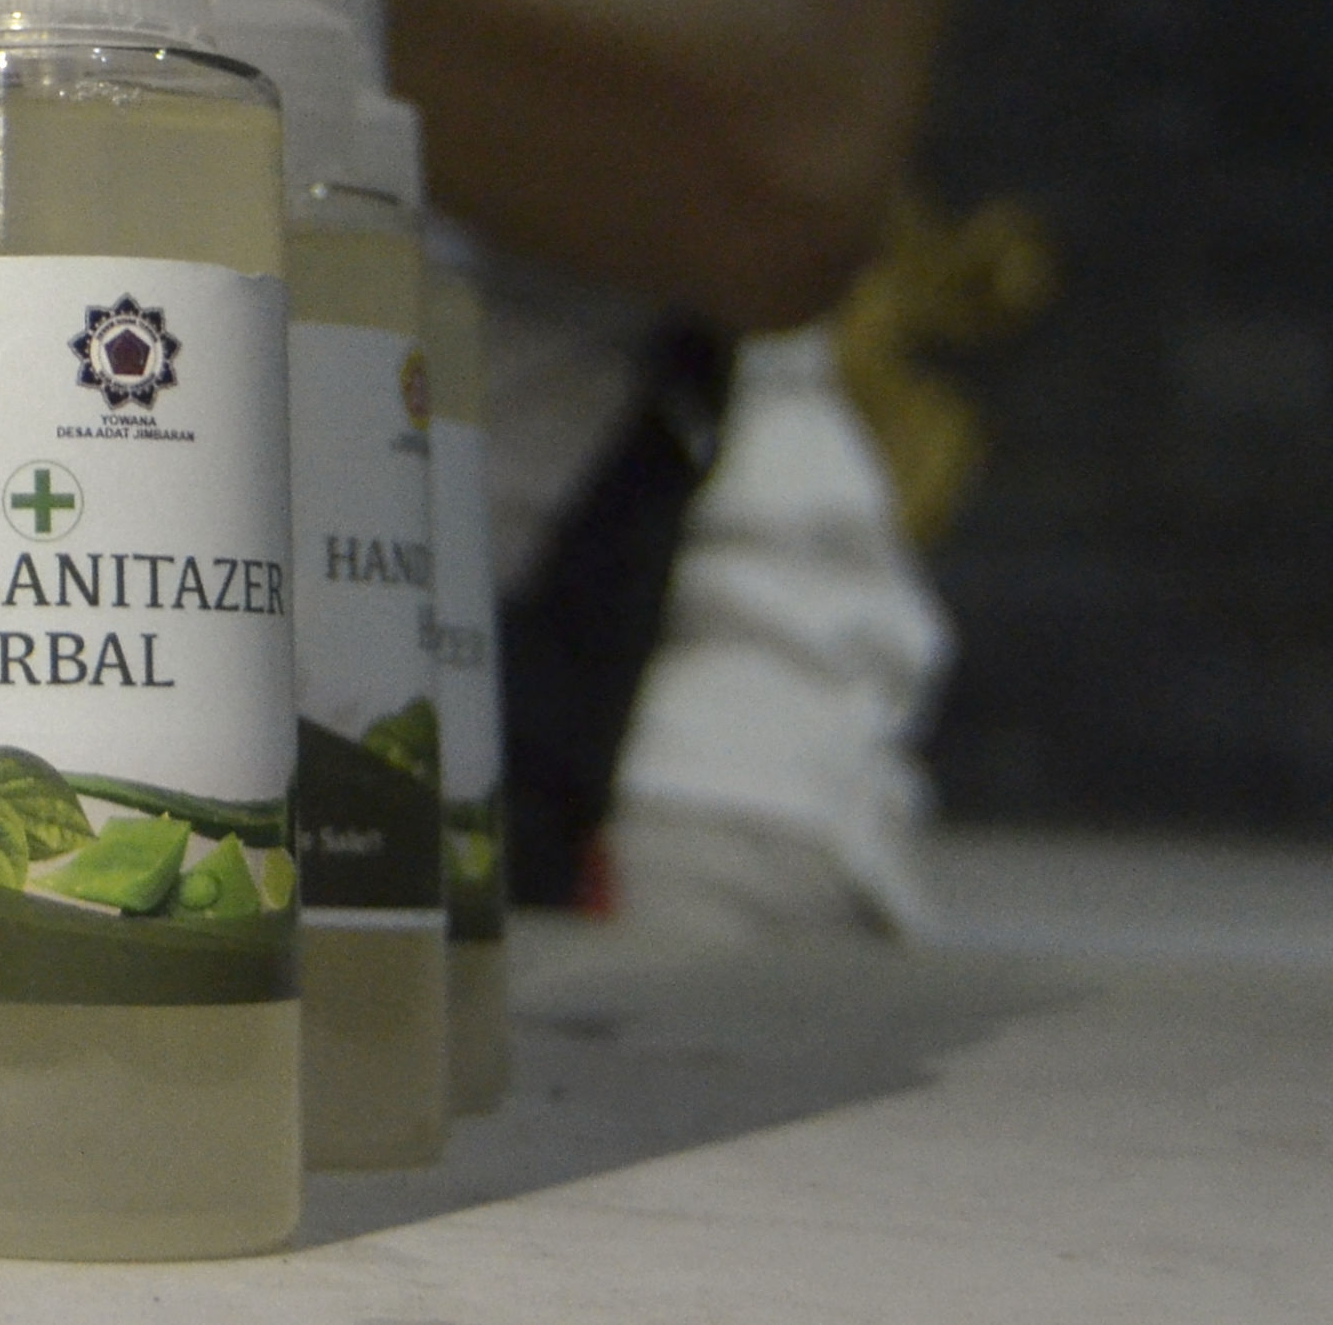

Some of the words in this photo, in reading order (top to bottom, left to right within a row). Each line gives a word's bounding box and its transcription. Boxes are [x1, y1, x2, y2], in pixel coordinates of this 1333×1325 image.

[101, 414, 157, 427] YOWANA
[56, 426, 93, 439] DESA
[95, 427, 130, 439] ADAT
[133, 427, 195, 443] JIMBARAN
